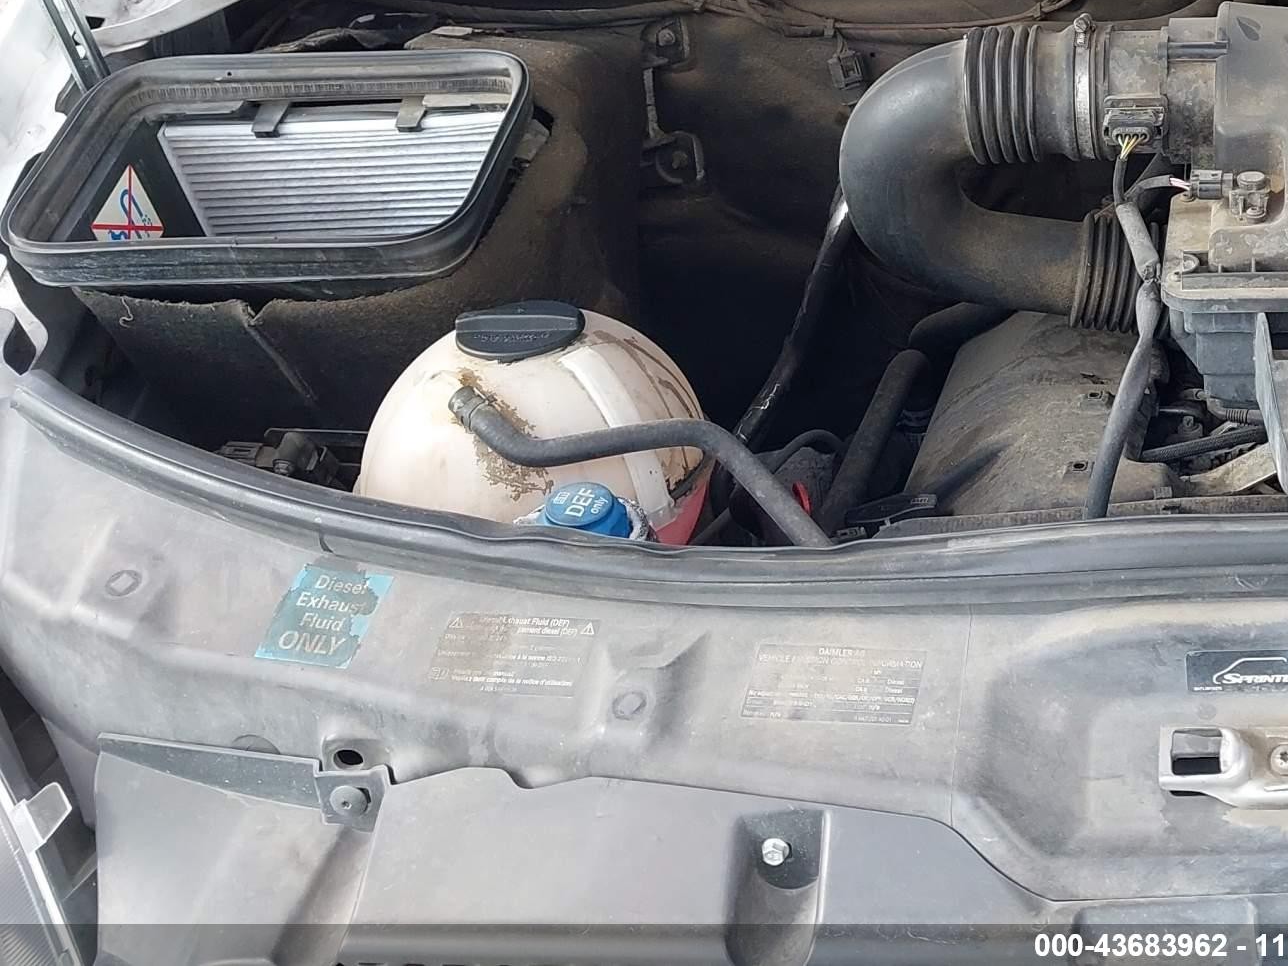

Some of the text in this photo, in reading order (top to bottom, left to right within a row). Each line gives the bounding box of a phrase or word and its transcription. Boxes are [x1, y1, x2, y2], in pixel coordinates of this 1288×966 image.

[564, 488, 595, 517] DEF
[591, 497, 608, 514] only
[315, 575, 368, 595] Diesel
[300, 612, 346, 631] Fluid
[532, 618, 550, 626] Fluid
[550, 618, 570, 628] (DEF)
[278, 630, 346, 655] ONLY
